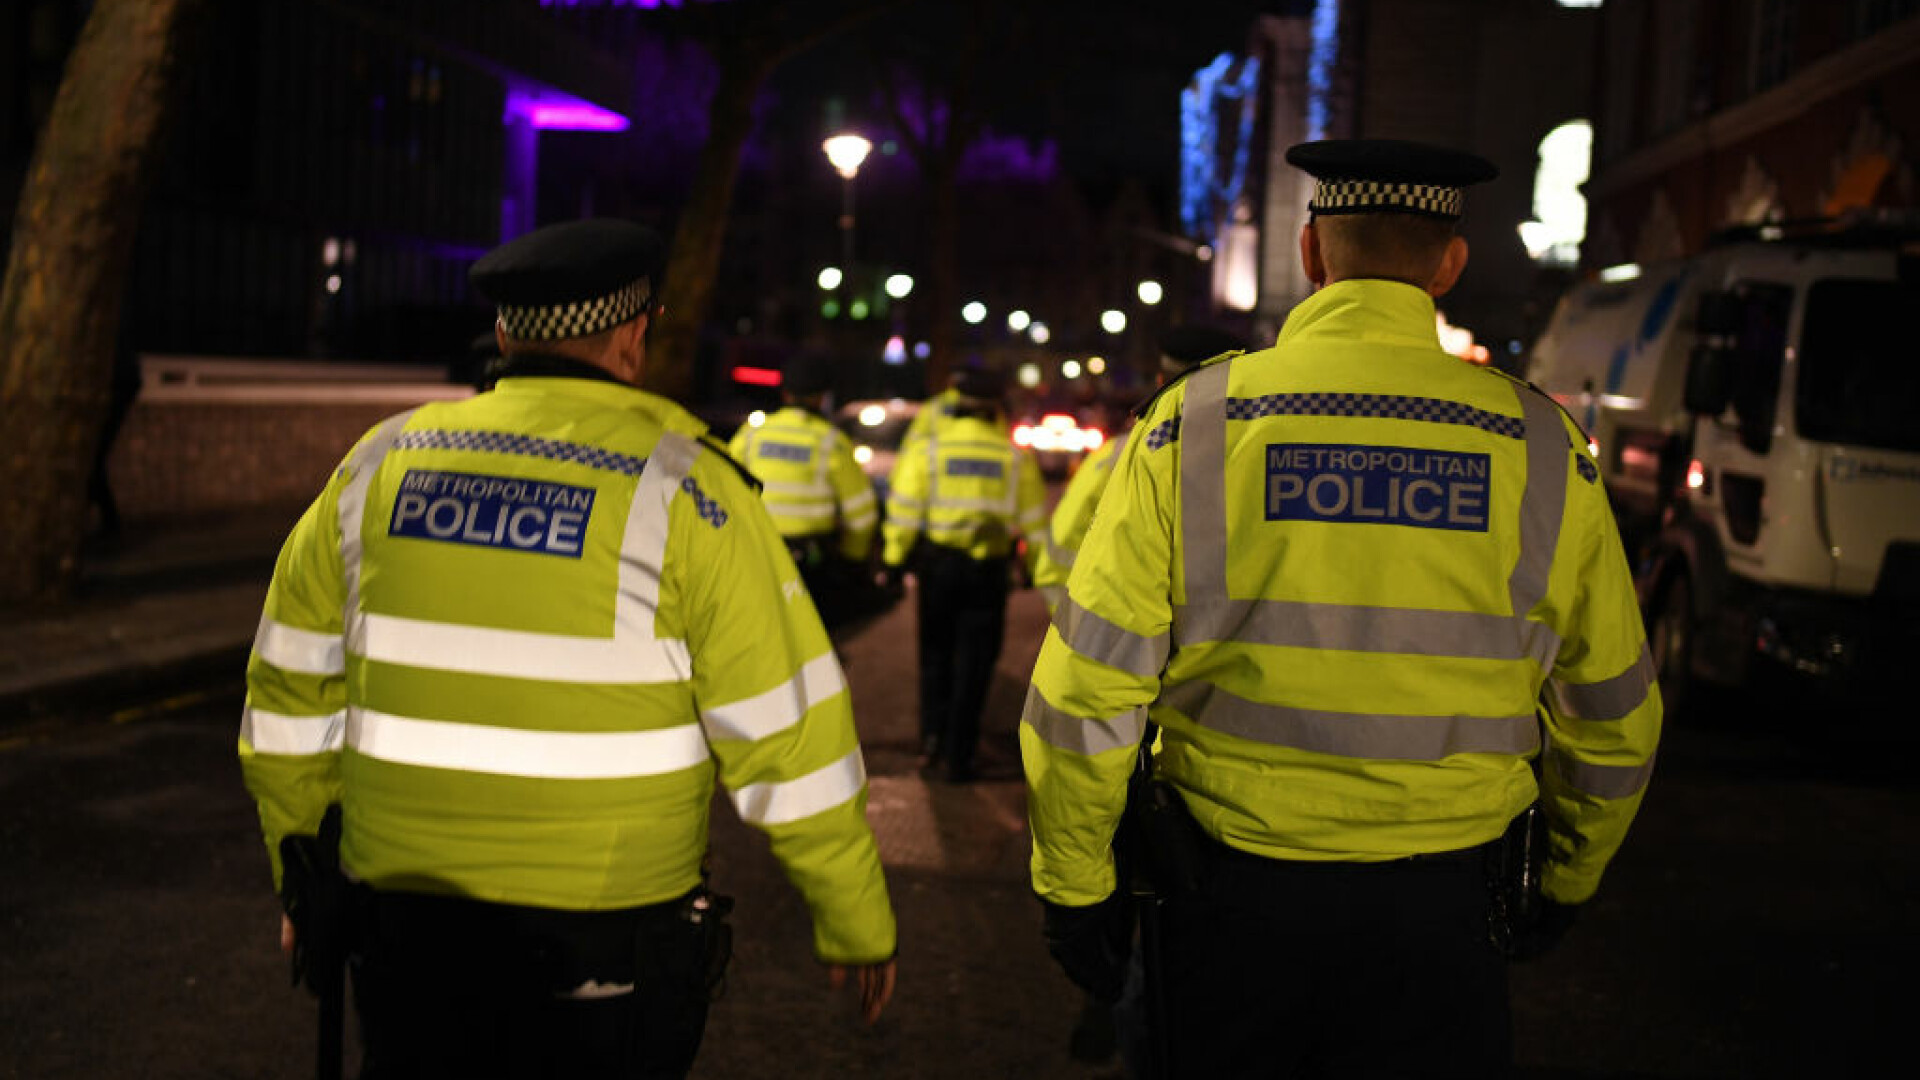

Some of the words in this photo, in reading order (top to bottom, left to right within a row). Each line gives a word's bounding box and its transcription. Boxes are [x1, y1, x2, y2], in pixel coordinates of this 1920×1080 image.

[1270, 449, 1486, 478] METROPOLITAN
[404, 471, 591, 511] METROPOLITAN
[1269, 473, 1484, 524] POLICE
[393, 494, 584, 553] POLICE
